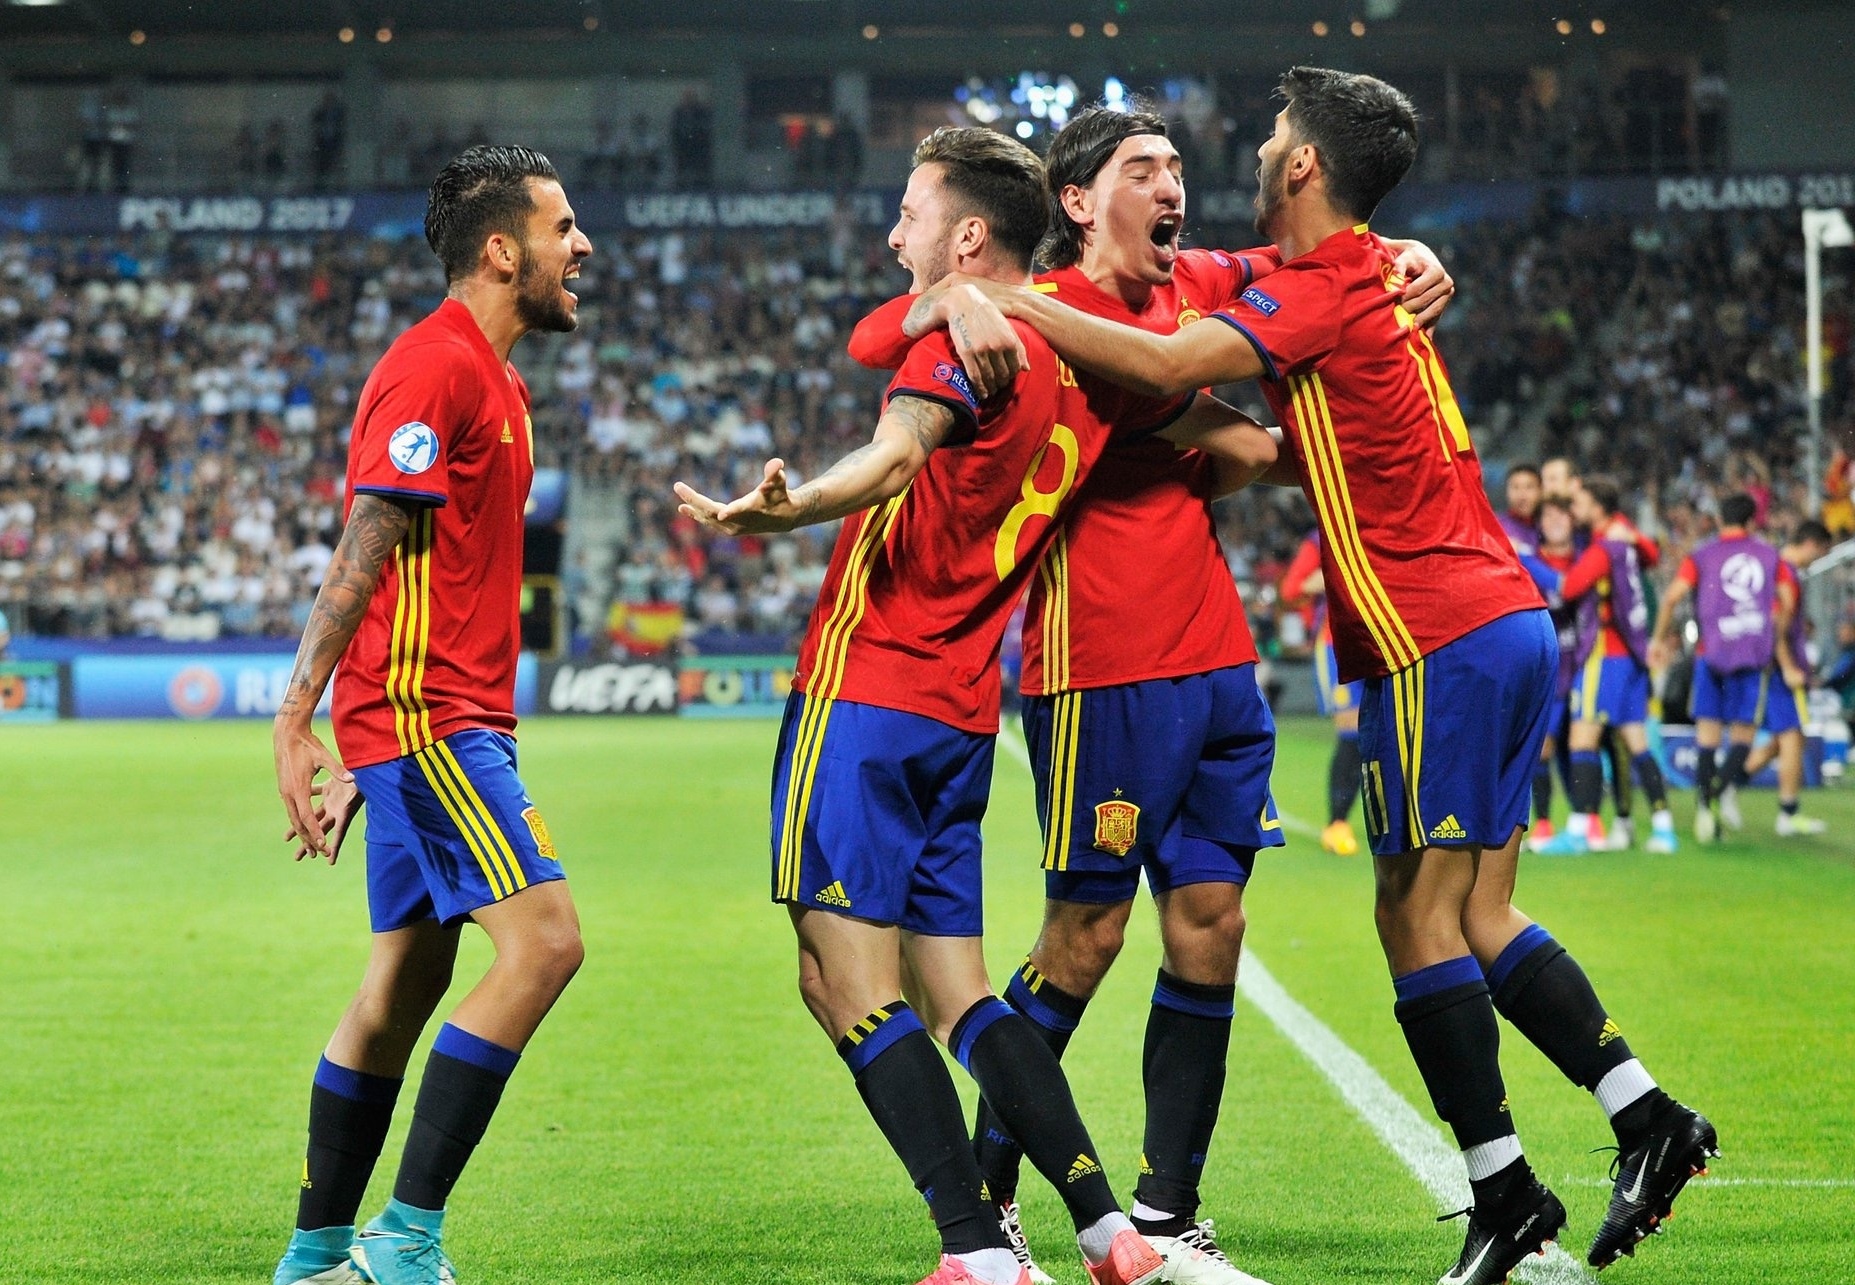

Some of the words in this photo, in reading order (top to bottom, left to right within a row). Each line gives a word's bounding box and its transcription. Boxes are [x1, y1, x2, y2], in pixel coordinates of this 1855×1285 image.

[625, 194, 717, 227] UEFA
[1657, 177, 1790, 211] POLAND
[119, 198, 263, 231] POLAND
[267, 198, 355, 230] 2017
[1244, 290, 1277, 313] SPECT
[993, 422, 1079, 583] 8
[549, 663, 677, 713] UEFA
[1361, 760, 1390, 836] 11
[1429, 829, 1467, 839] adidas
[815, 893, 851, 908] adidas
[1067, 1165, 1101, 1183] adidas
